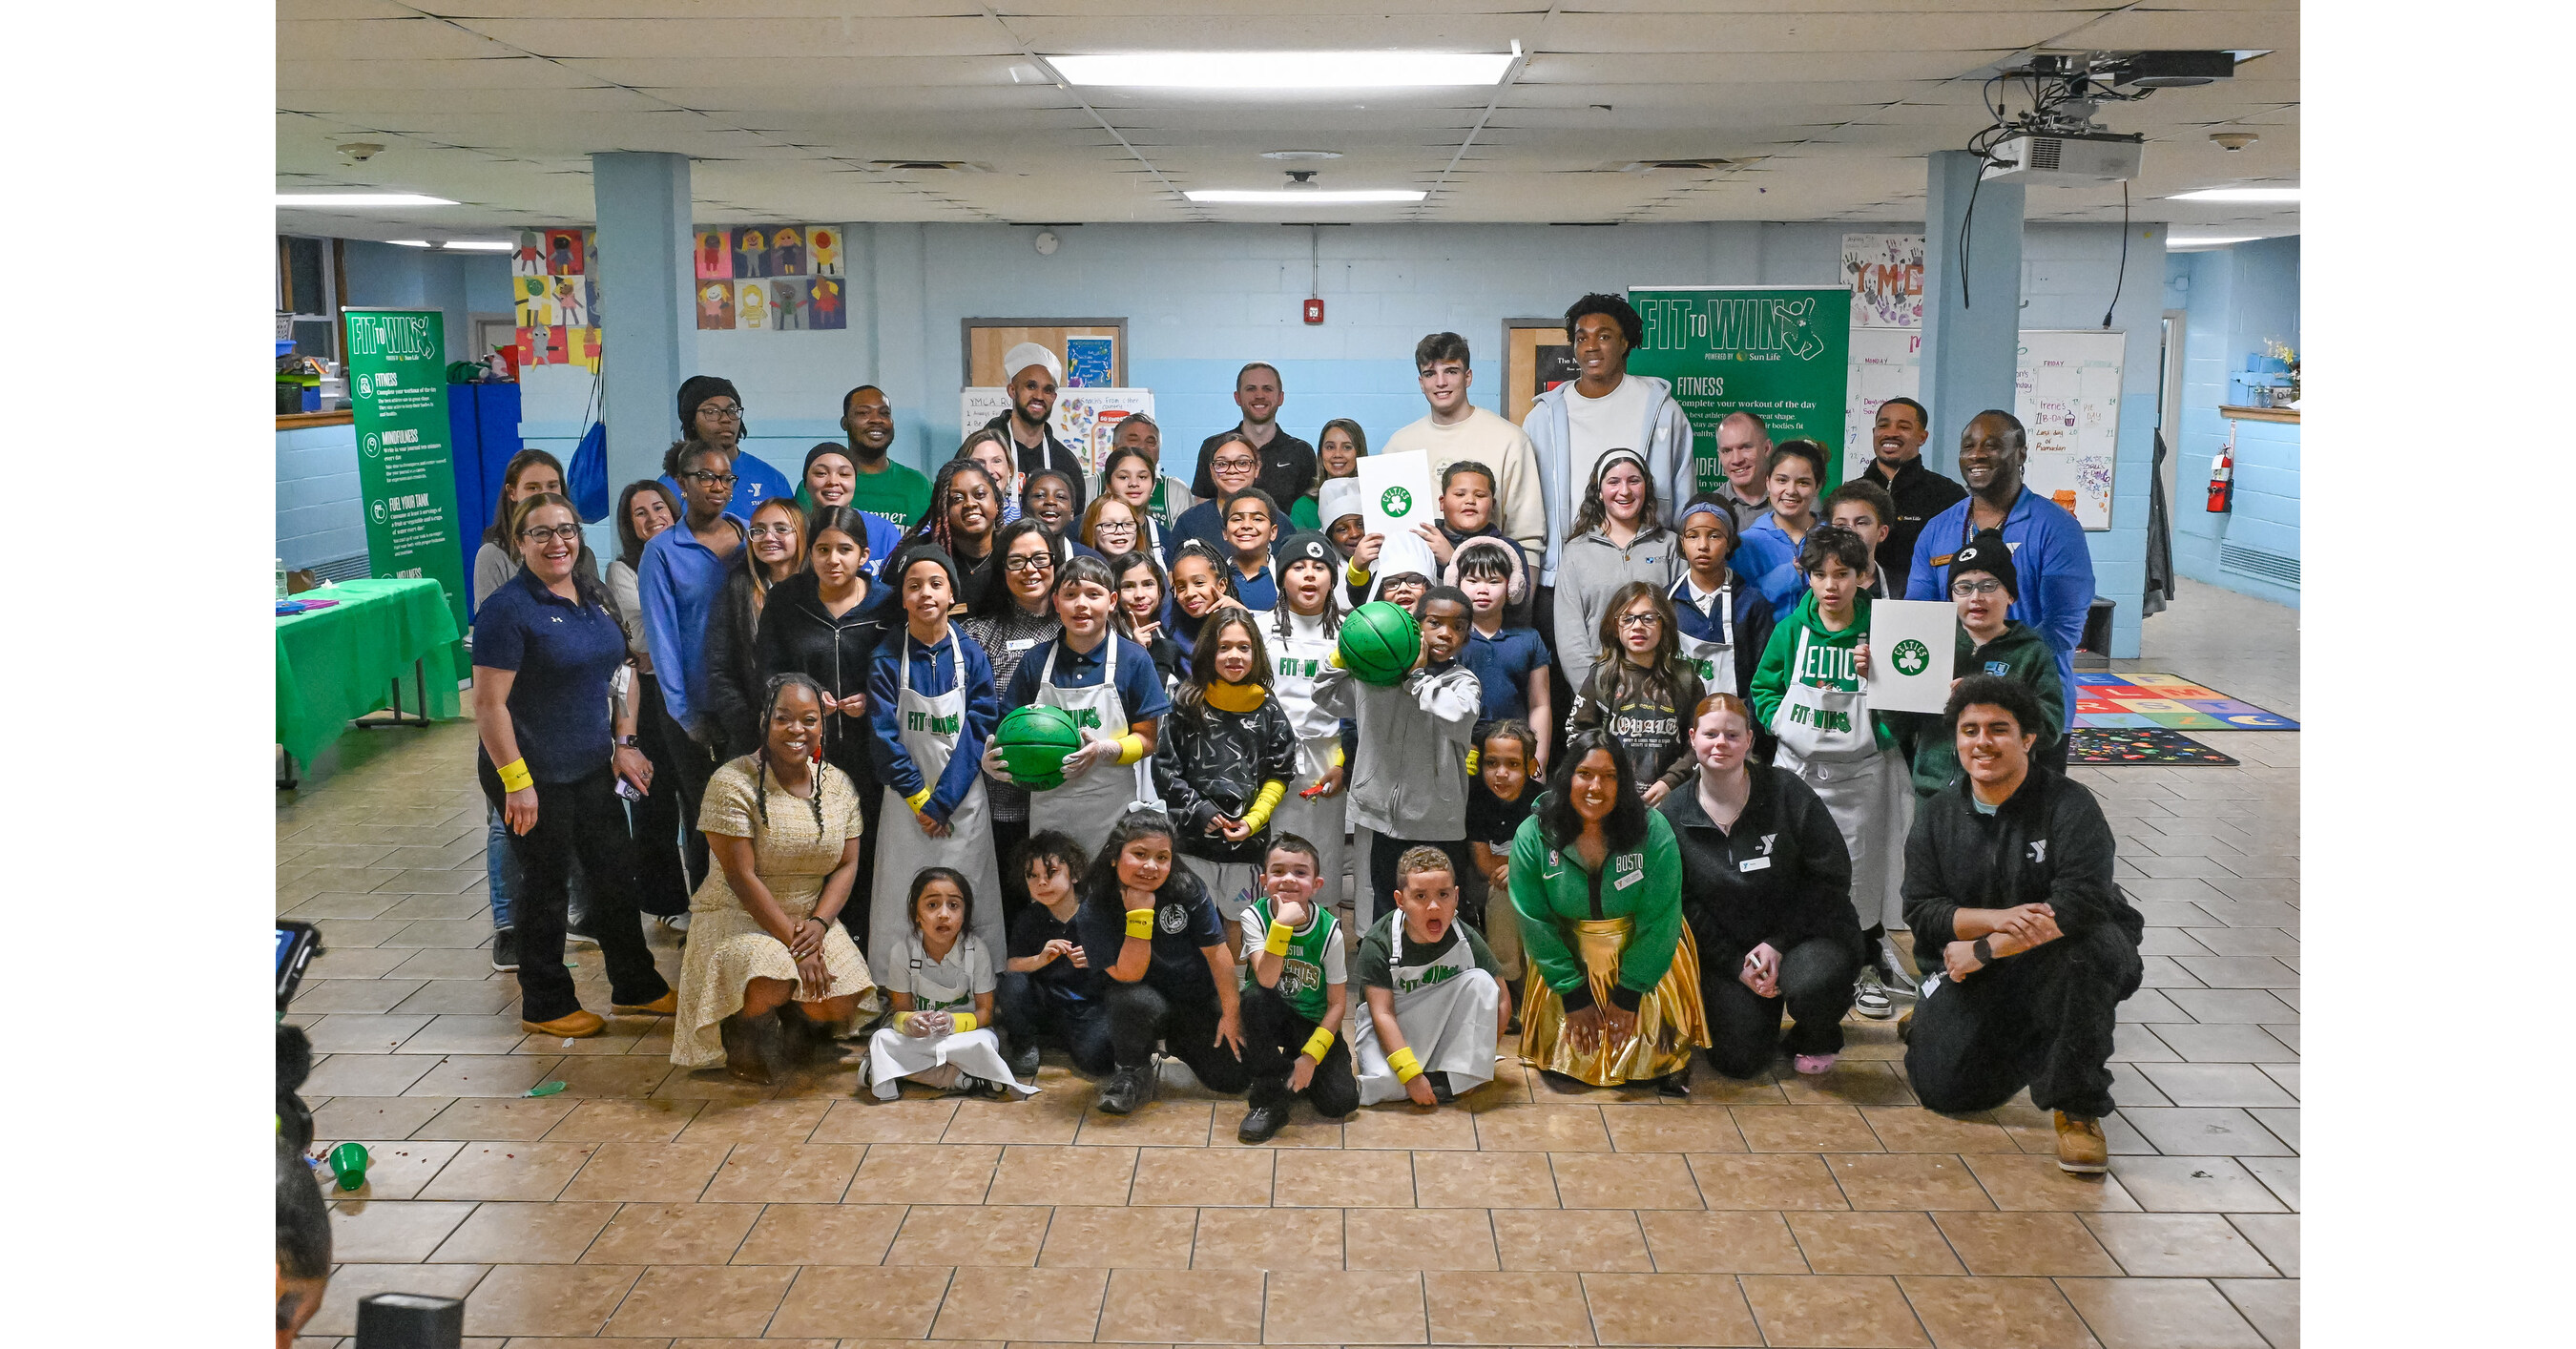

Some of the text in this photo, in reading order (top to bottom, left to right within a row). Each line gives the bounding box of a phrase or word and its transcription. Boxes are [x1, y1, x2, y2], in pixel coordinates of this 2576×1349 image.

[1640, 299, 1785, 350] FIT TO WIN
[352, 317, 419, 354] FIT TO WIN
[375, 373, 397, 387] FITNESS
[1677, 377, 1724, 396] FITNESS
[970, 398, 995, 406] YMCA
[1677, 399, 1715, 408] Complete
[1717, 401, 1736, 409] your
[1738, 400, 1772, 408] workout
[1774, 400, 1783, 408] of
[1800, 401, 1817, 411] day
[2040, 401, 2066, 410] Irene's
[382, 429, 418, 445] MINDFULNESS
[2036, 443, 2066, 451] Ramadan
[389, 493, 429, 512] FUEL YOUR TANK
[1382, 488, 1410, 502] CELTICS
[1894, 641, 1927, 657] CELTICS
[1280, 657, 1299, 676] FIT
[2160, 688, 2209, 696] M
[908, 711, 926, 731] FIT
[1790, 703, 1810, 725] FIT
[1813, 709, 1838, 729] WIN
